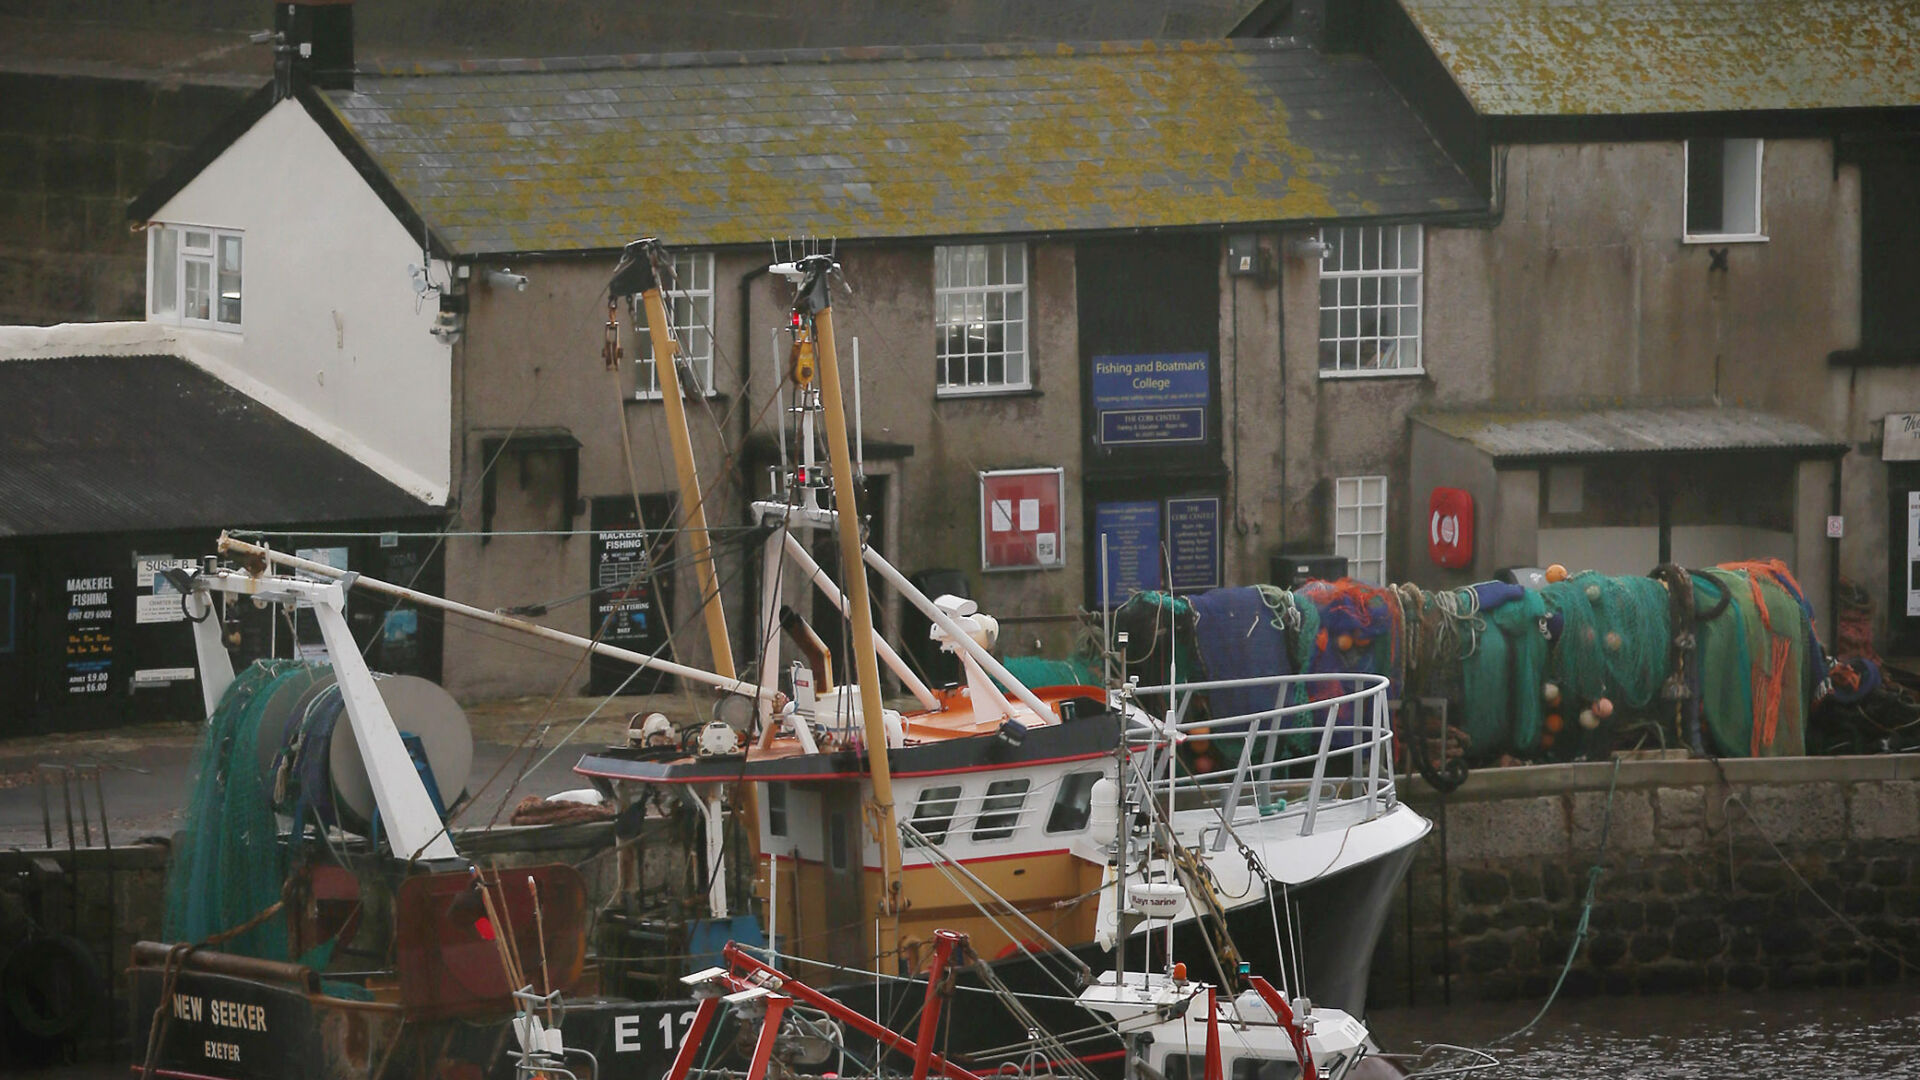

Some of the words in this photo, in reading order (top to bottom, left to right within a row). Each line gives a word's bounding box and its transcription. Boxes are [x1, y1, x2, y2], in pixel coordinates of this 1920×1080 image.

[1096, 362, 1132, 376] Fishing
[1134, 361, 1153, 373] and
[1155, 359, 1206, 372] Boatman's
[1132, 377, 1170, 391] College
[600, 530, 649, 540] MACKERE
[606, 539, 641, 550] FISHING
[67, 577, 113, 591] MACKEREL
[72, 592, 107, 606] FISHING
[626, 602, 649, 611] FISHING
[88, 672, 108, 682] £9.00
[87, 682, 107, 692] £6.00
[173, 993, 202, 1022] NEW
[211, 999, 267, 1032] SEEKER
[615, 1015, 641, 1052] E
[204, 1040, 241, 1062] EXETER
